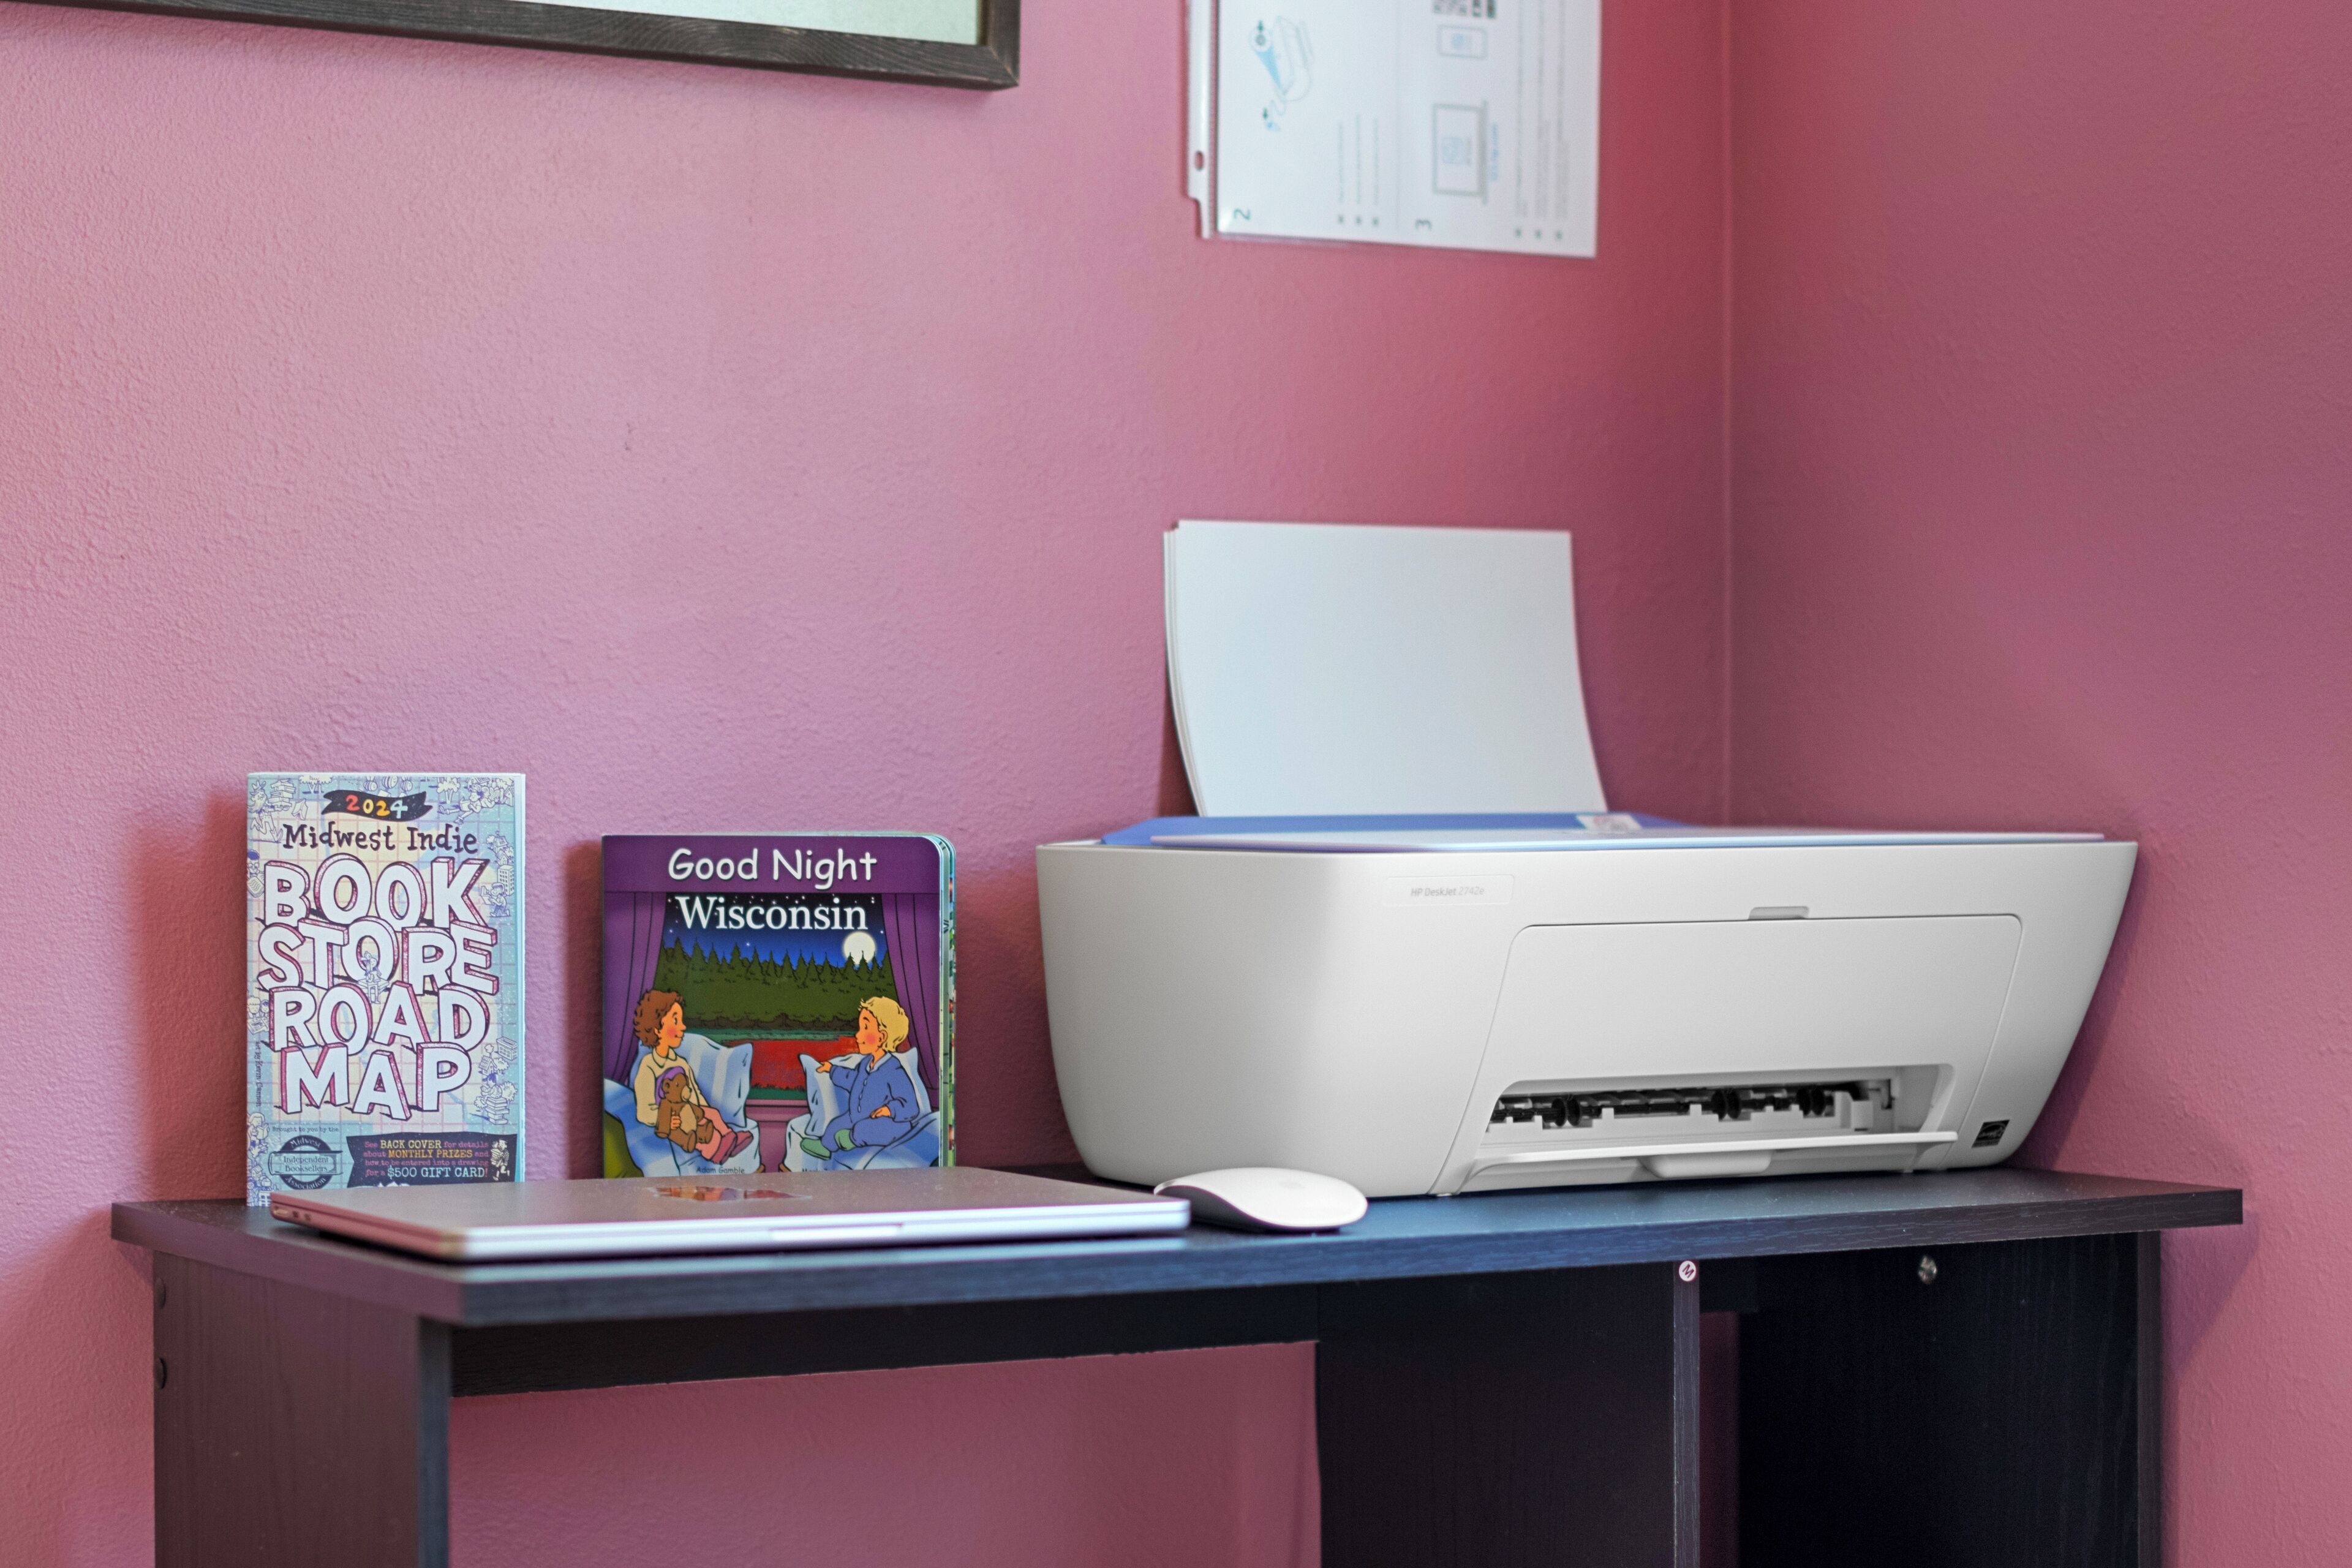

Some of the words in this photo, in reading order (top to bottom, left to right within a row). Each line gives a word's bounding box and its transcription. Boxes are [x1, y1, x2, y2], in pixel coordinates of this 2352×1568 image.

[345, 794, 409, 819] 2024
[282, 821, 396, 851] Midwest
[407, 823, 479, 853] Indie
[668, 848, 759, 880] Good
[773, 848, 878, 890] Night
[264, 853, 490, 932] BOOK
[1411, 888, 1423, 897] HP
[1424, 888, 1457, 896] DeskJet
[1459, 886, 1485, 895] 2742e
[675, 896, 869, 930] Wisconsin
[257, 916, 499, 996] STORE
[269, 981, 491, 1056] ROAD
[280, 1042, 472, 1121] MAP
[290, 1137, 322, 1148] Midwest
[380, 1140, 405, 1148] BACK
[408, 1140, 442, 1149] COVER
[388, 1150, 433, 1158] MONTHLY
[437, 1149, 473, 1158] PRIZES
[285, 1177, 326, 1190] Association
[387, 1165, 417, 1180] $500
[421, 1167, 451, 1177] GIFT
[454, 1167, 488, 1177] CARD!
